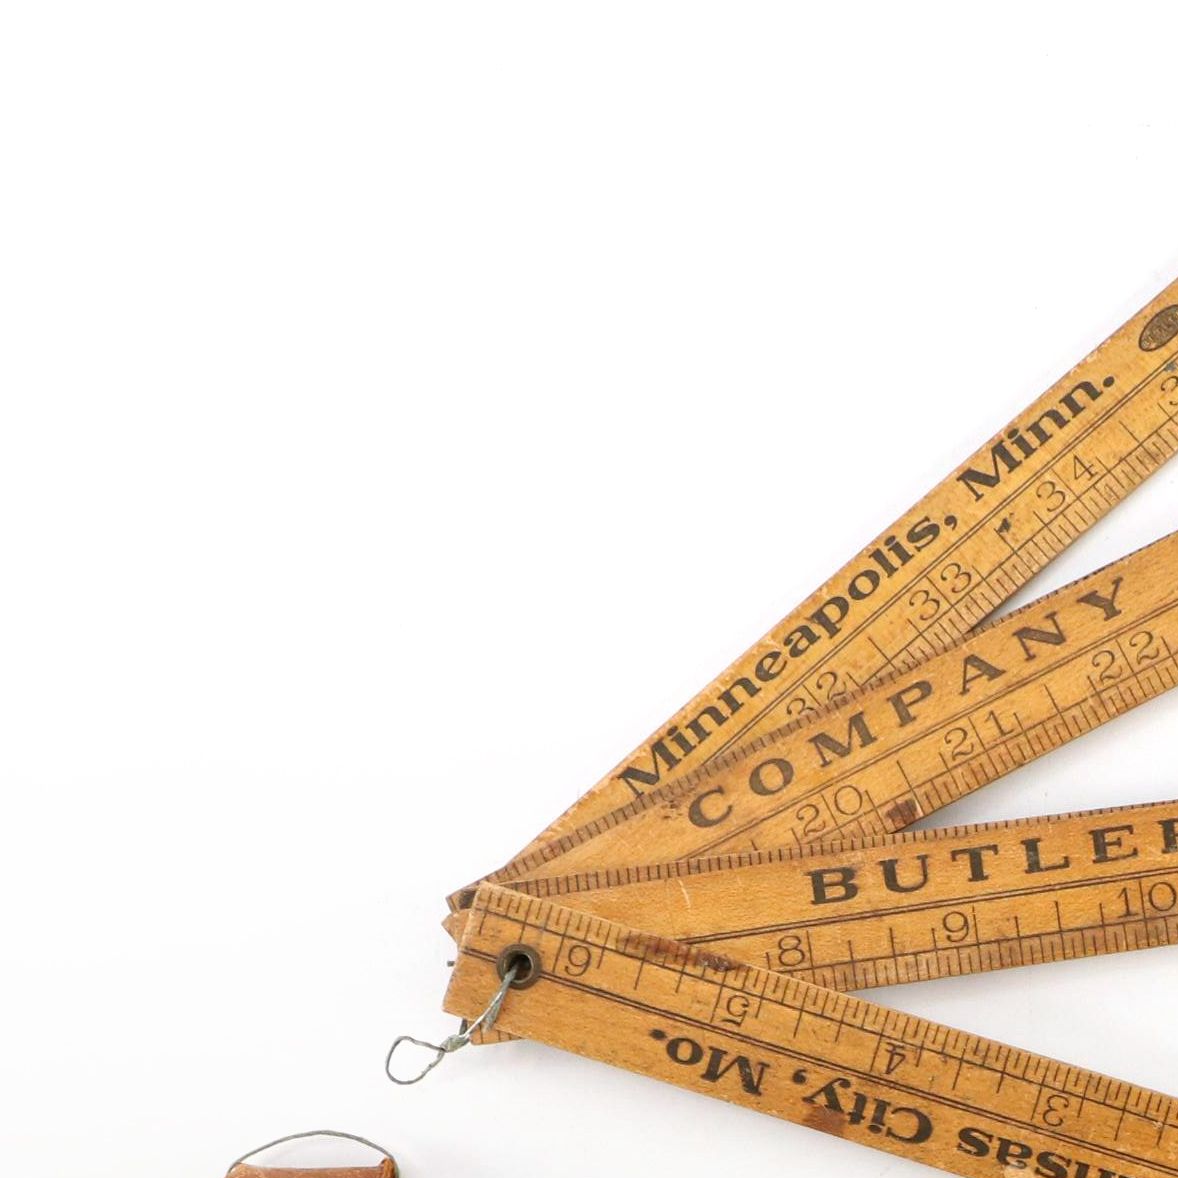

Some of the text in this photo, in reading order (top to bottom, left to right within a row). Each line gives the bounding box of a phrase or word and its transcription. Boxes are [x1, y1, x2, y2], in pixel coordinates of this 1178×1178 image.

[617, 374, 1116, 798] Minneapolis, Minn.
[908, 562, 974, 623] 33
[1036, 455, 1099, 515] 34
[688, 577, 1130, 828] COMPANY
[796, 785, 862, 836] 20
[945, 708, 1010, 760] 21
[1092, 631, 1159, 684] 22
[777, 935, 805, 967] 8
[942, 911, 969, 942] 9
[1117, 881, 1177, 919] 10
[564, 945, 592, 977] 6
[721, 994, 751, 1028] 5
[884, 1042, 906, 1075] 4
[1043, 1094, 1070, 1128] 3
[650, 1028, 771, 1097] Mo.
[791, 1068, 934, 1145] City,
